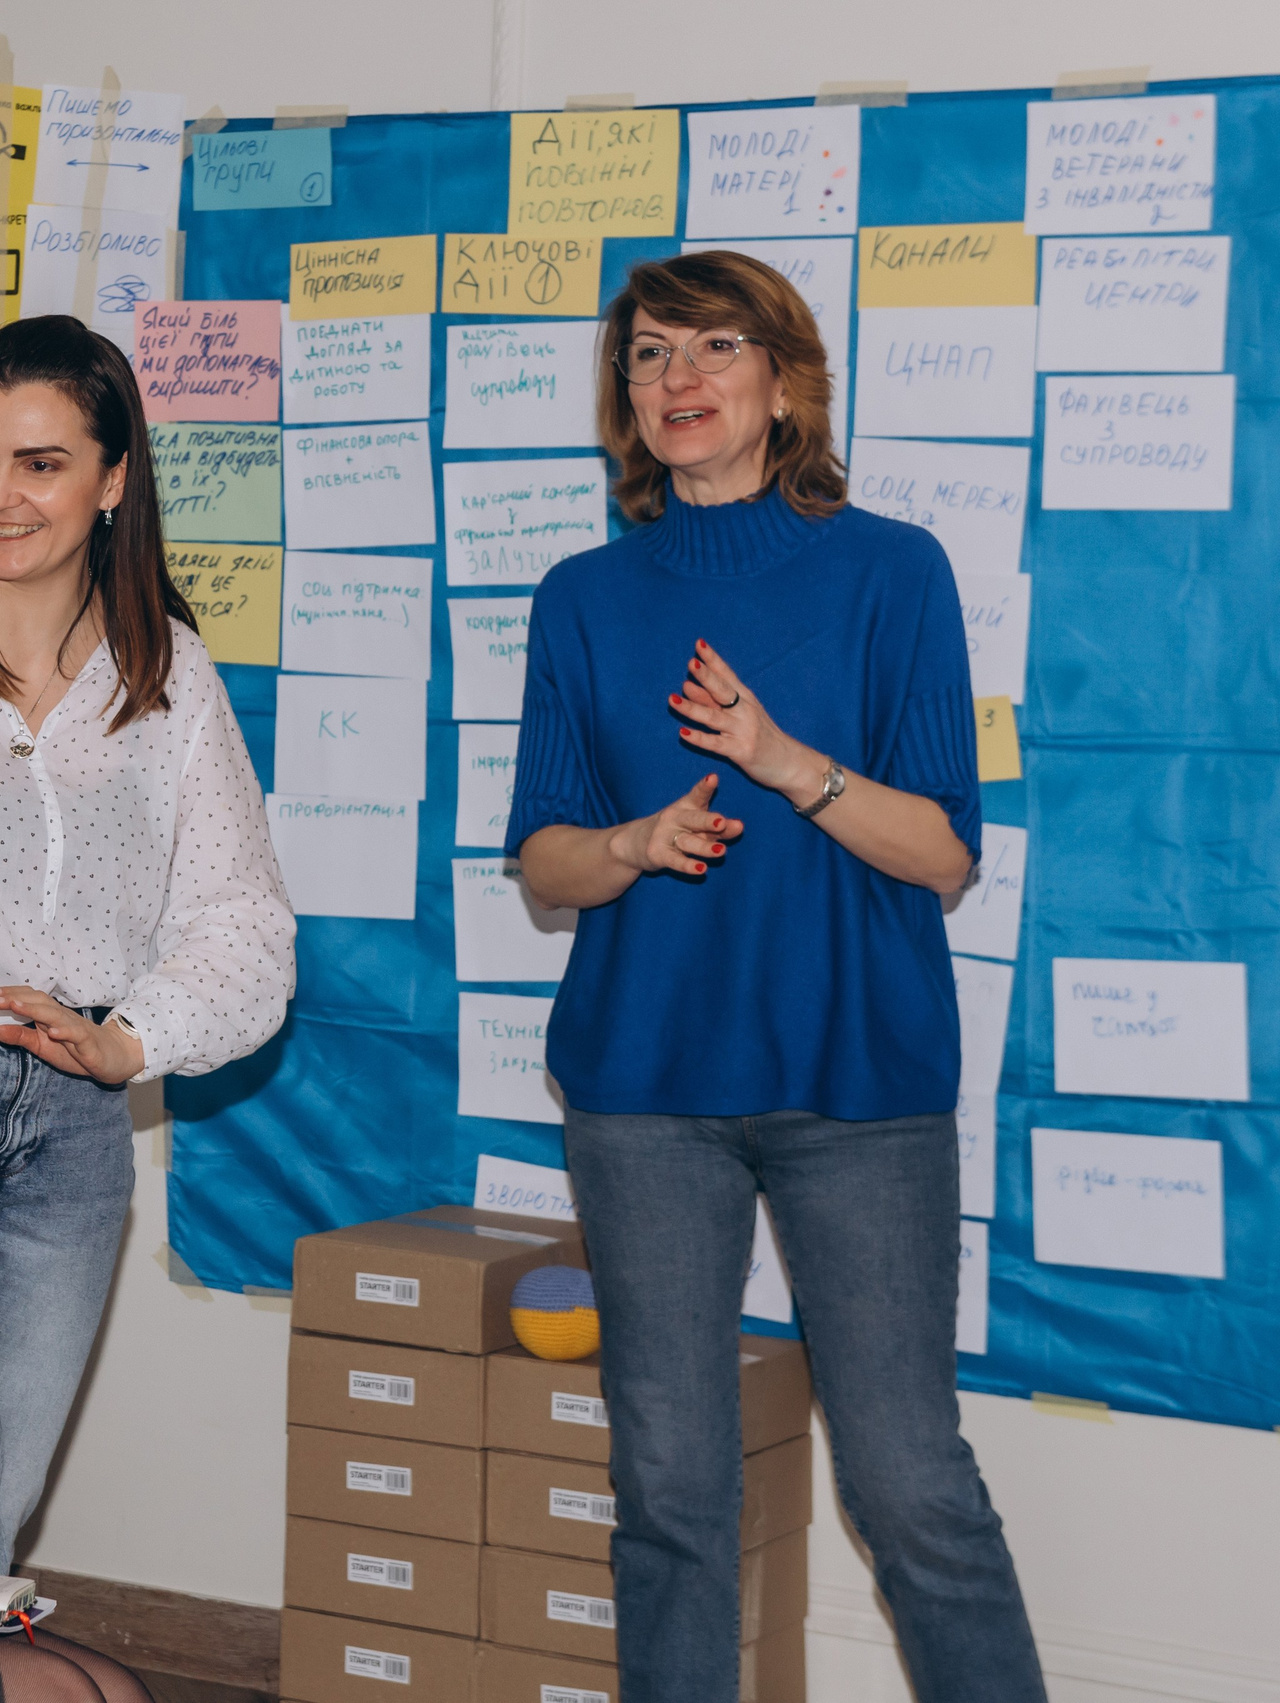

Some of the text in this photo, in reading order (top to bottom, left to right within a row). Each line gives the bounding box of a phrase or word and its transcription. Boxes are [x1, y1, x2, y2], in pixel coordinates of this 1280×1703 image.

[709, 126, 815, 160] МОЛОДІ
[1046, 116, 1152, 147] МОЛОДІ
[1051, 152, 1186, 181] ВЕТЕРАНИ
[711, 163, 805, 197] МАТЕРІ
[457, 237, 594, 265] КЛЮЧОВІ
[1084, 281, 1200, 311] ЦЕНТРИ
[885, 341, 993, 387] ЦНАП
[1059, 387, 1190, 416] ФАХІВЕЦЬ
[1060, 443, 1208, 472] СУПРОВОДУ
[981, 708, 995, 729] 3
[359, 1281, 391, 1292] STARTER
[352, 1379, 385, 1391] STARTER
[556, 1401, 591, 1413] STARTER
[350, 1470, 382, 1482] STARTER
[553, 1497, 587, 1509] STARTER
[351, 1562, 384, 1575] STARTER
[551, 1600, 585, 1612] STARTER
[349, 1655, 381, 1669] STARTER
